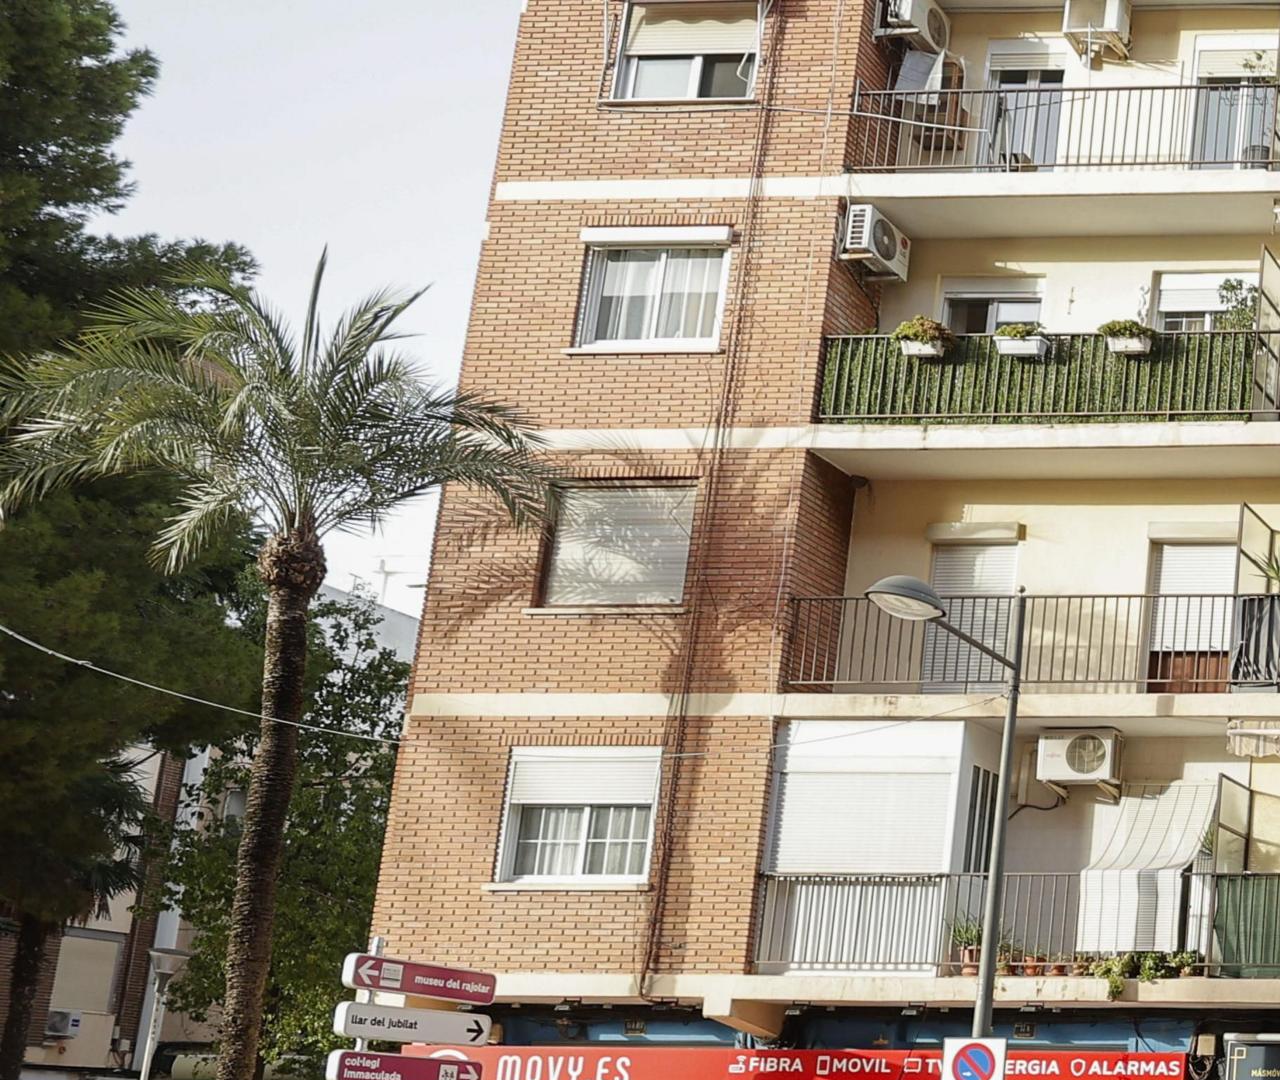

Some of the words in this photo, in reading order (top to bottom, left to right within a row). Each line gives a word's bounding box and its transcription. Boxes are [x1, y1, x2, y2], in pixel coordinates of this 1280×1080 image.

[415, 975, 445, 988] museu
[446, 978, 461, 989] del
[462, 981, 491, 994] rajolar
[351, 1014, 367, 1025] llar
[370, 1016, 385, 1027] del
[387, 1017, 418, 1030] jubilat
[749, 1058, 803, 1072] FIBRA
[832, 1059, 891, 1073] MOVIL
[1004, 1060, 1060, 1075] ERGIA
[1088, 1060, 1181, 1076] ALARMAS
